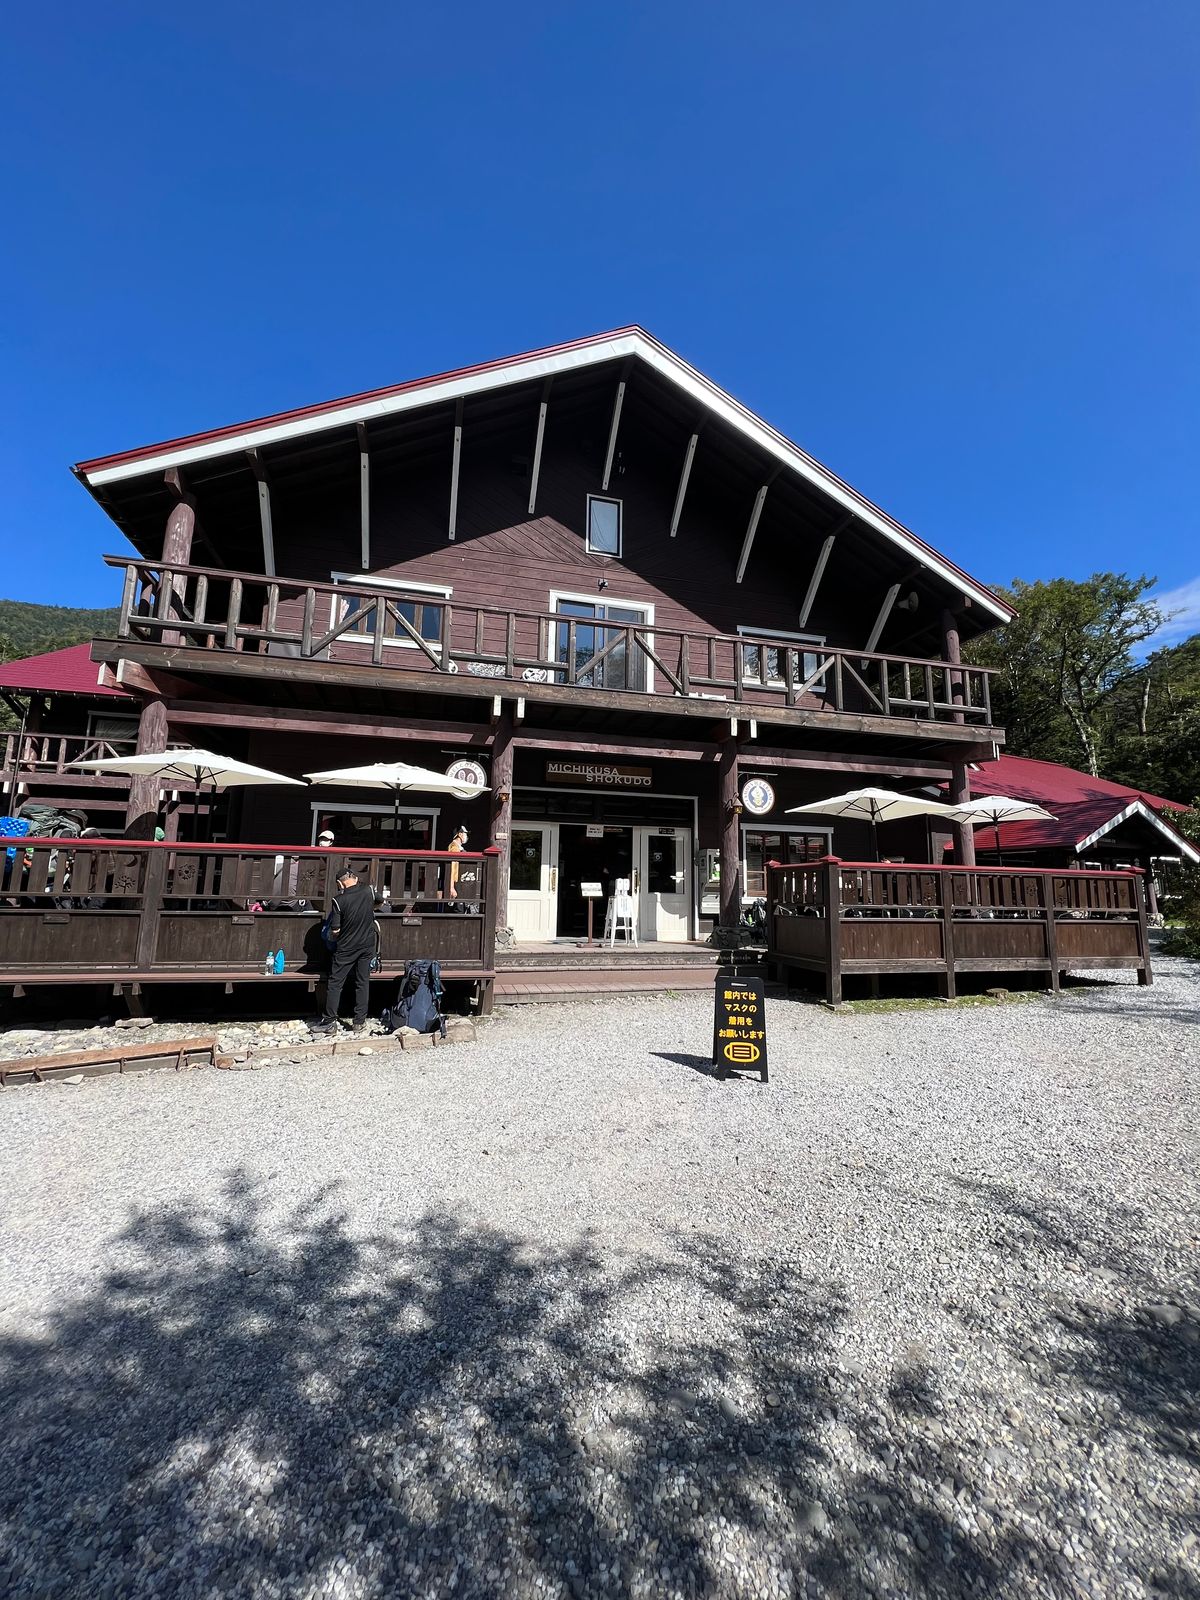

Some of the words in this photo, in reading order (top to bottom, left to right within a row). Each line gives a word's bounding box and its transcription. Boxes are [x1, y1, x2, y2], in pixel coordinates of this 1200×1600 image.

[449, 762, 478, 777] WELCOME
[548, 763, 619, 775] MICHIKUSA
[586, 774, 652, 786] SHOKUDO
[724, 990, 757, 1001] 館内では
[724, 1003, 757, 1013] マスクの
[728, 1016, 753, 1026] 着用を
[718, 1028, 765, 1039] お願いします
